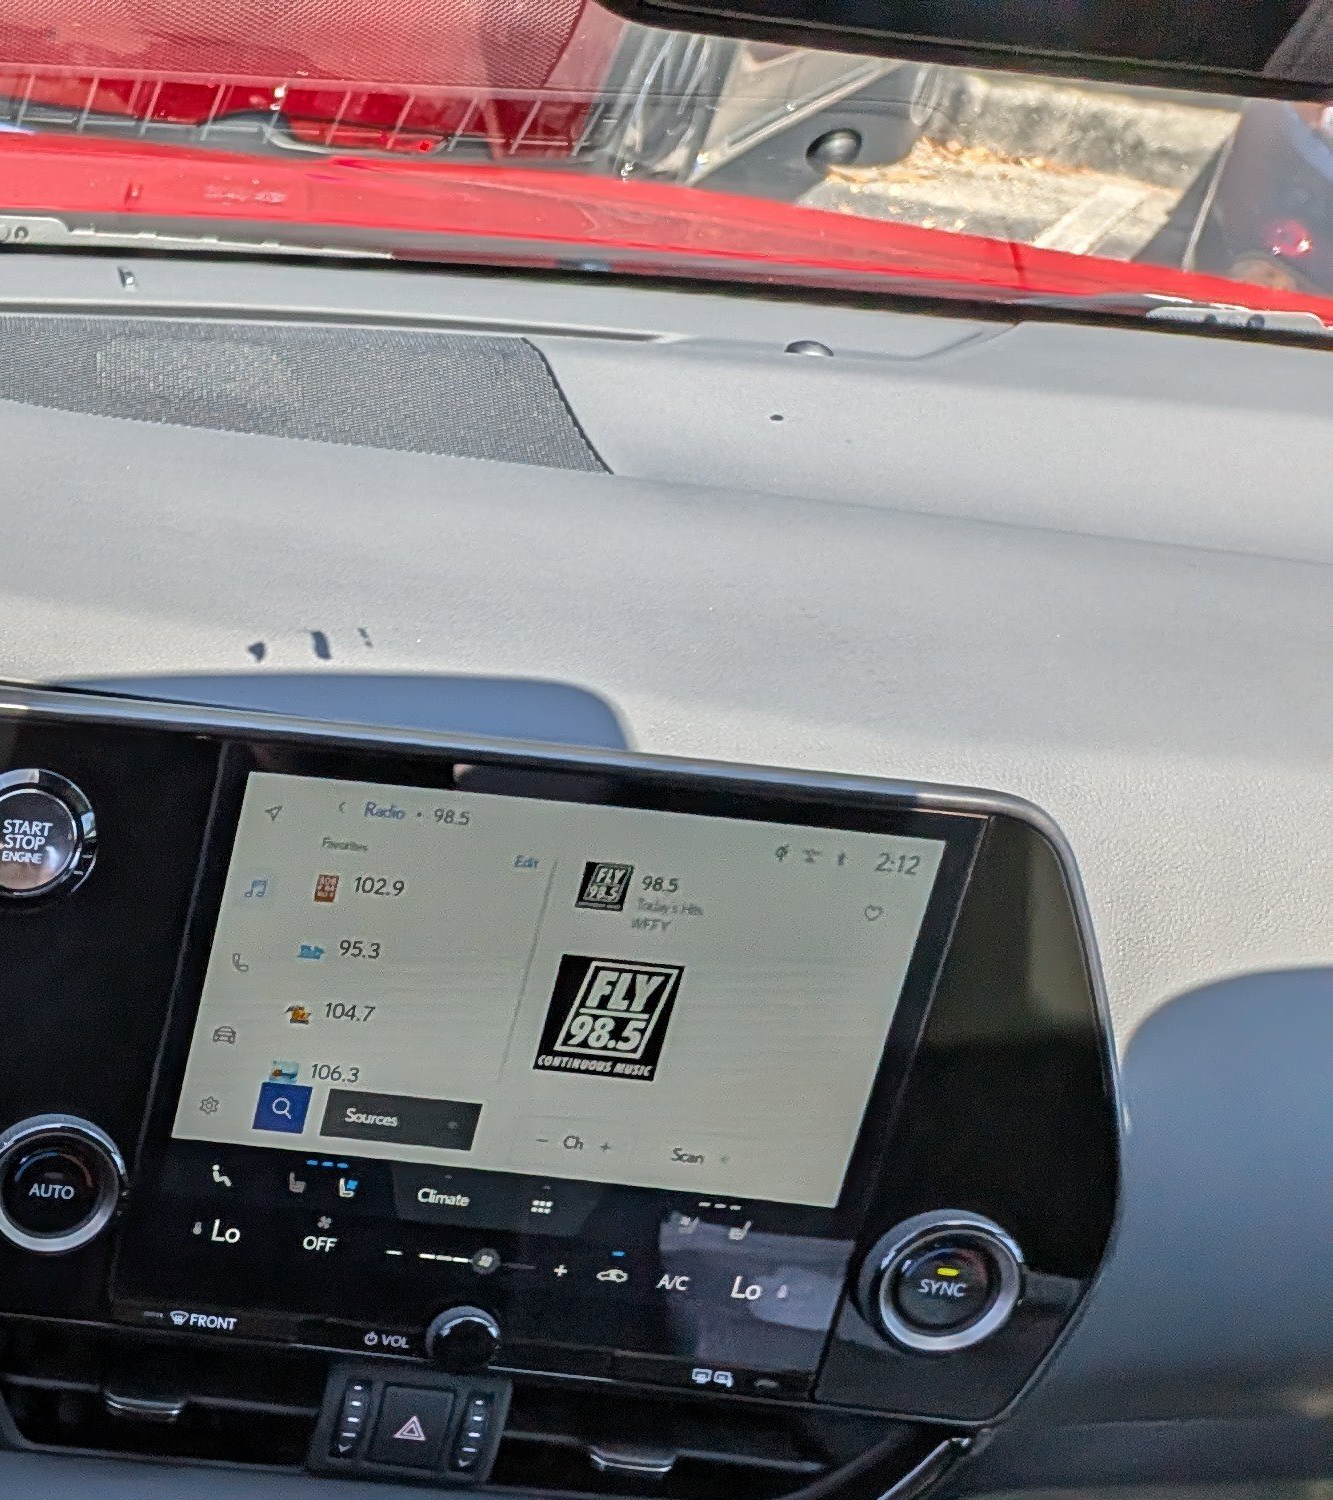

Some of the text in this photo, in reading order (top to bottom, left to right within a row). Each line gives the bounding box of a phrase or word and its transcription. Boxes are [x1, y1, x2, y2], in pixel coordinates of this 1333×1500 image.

[364, 801, 471, 826] Radio 98.5
[2, 819, 53, 837] START
[3, 834, 46, 851] STOP
[1, 850, 43, 865] ENGINE
[874, 851, 921, 875] 2:12
[597, 867, 626, 884] FLY
[641, 875, 679, 893] 98.5
[354, 876, 405, 897] 102.9
[338, 939, 381, 960] 95.3
[585, 969, 666, 1012] FLY
[324, 1002, 376, 1022] 104.7
[567, 1014, 648, 1051] 98.5
[310, 1062, 360, 1083] 106.3
[537, 1054, 654, 1077] CONTINUOUS MUSIC
[344, 1107, 399, 1127] Sources
[563, 1134, 584, 1149] Ch
[670, 1147, 705, 1165] Scan
[28, 1182, 75, 1200] AUTO
[417, 1187, 471, 1208] Climate
[210, 1218, 241, 1244] Lo
[302, 1235, 338, 1252] OFF
[655, 1274, 691, 1292] A/C
[730, 1275, 762, 1300] Lo
[917, 1278, 967, 1298] SYNC
[189, 1313, 238, 1331] FRONT
[382, 1333, 410, 1349] VOL
